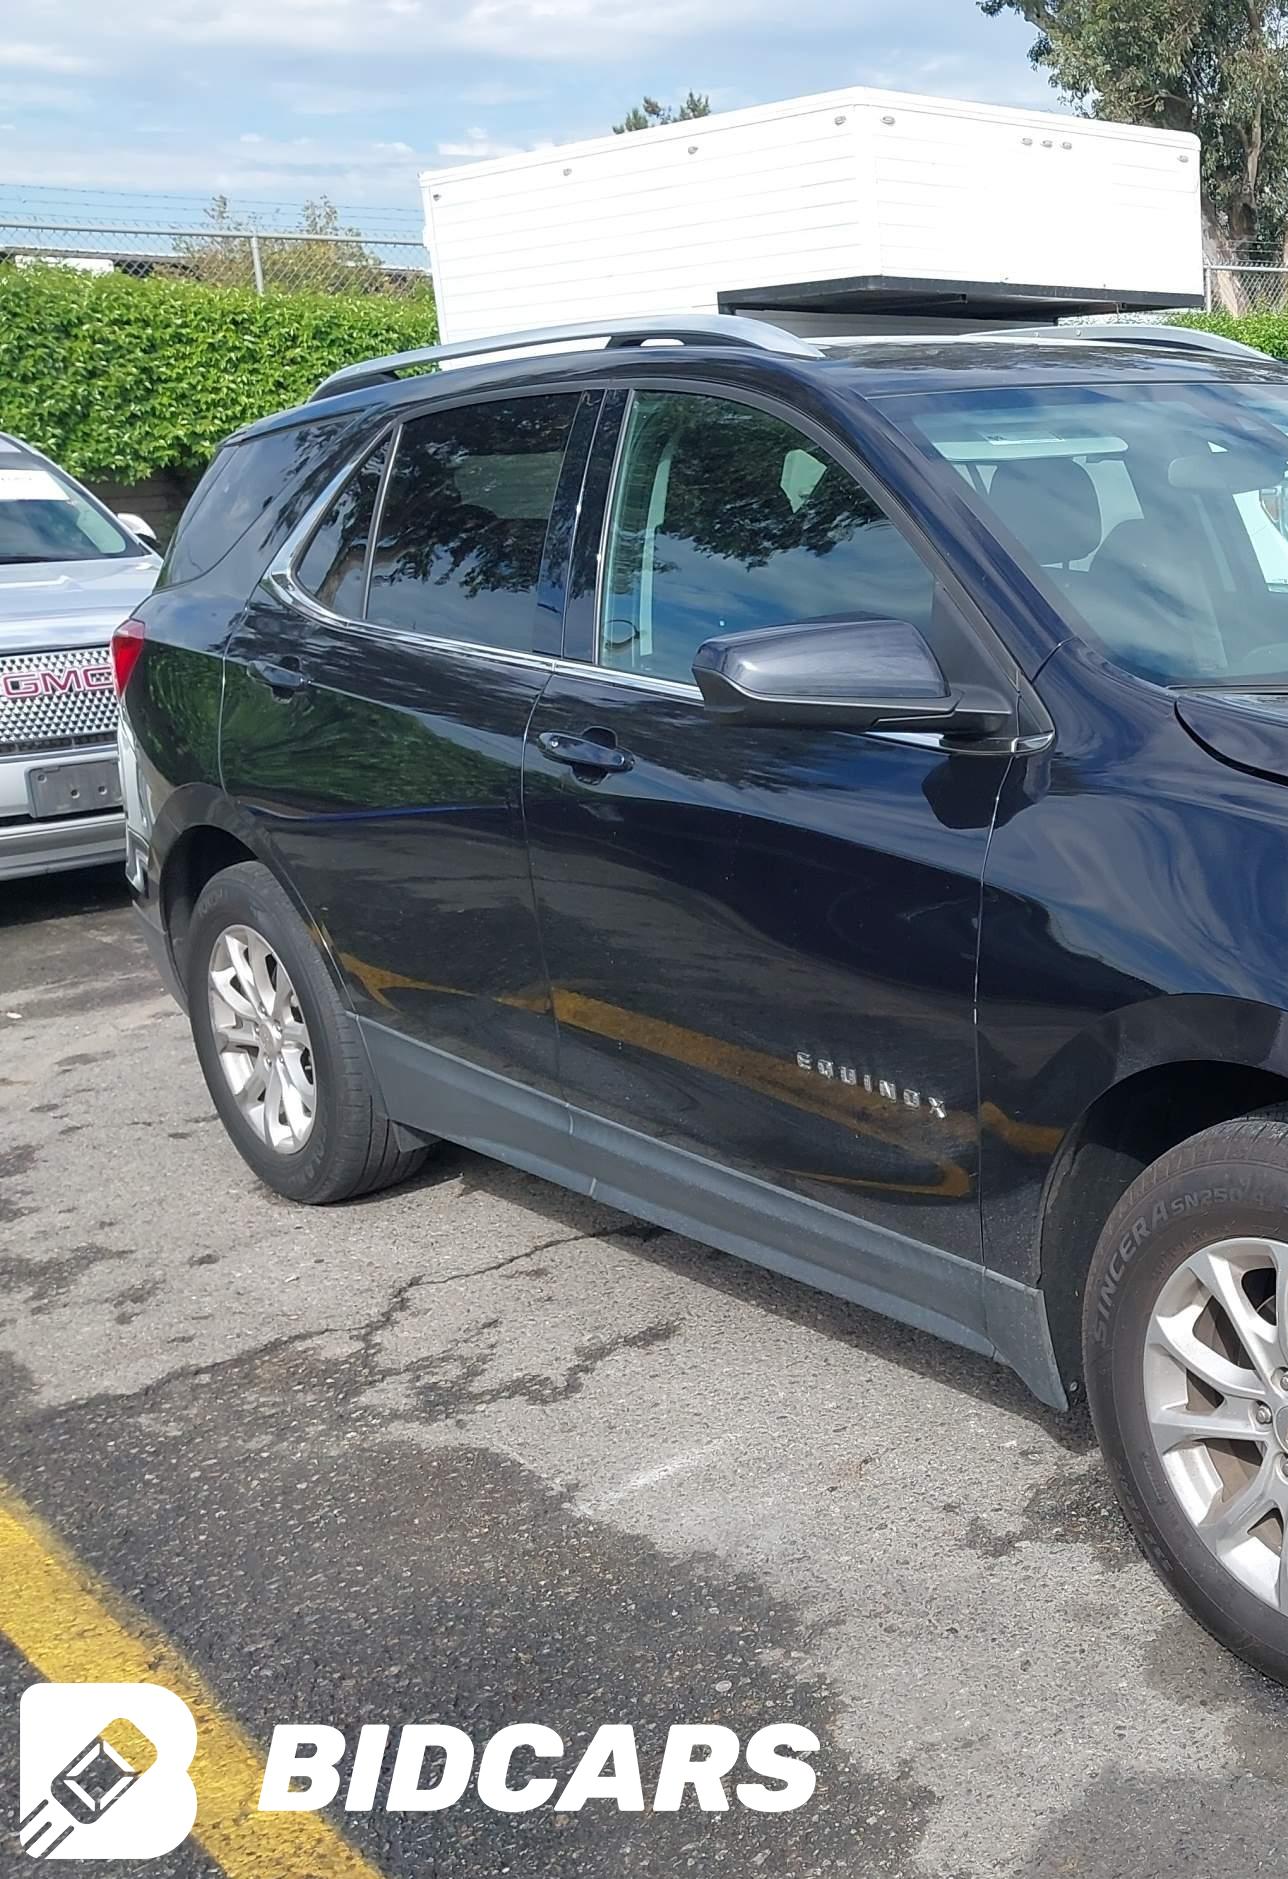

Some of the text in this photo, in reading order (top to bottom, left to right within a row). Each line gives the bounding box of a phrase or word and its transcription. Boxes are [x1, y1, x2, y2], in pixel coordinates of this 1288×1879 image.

[2, 664, 115, 698] GMC
[796, 1051, 947, 1120] EQUINOX
[1093, 1200, 1169, 1348] SINCERA
